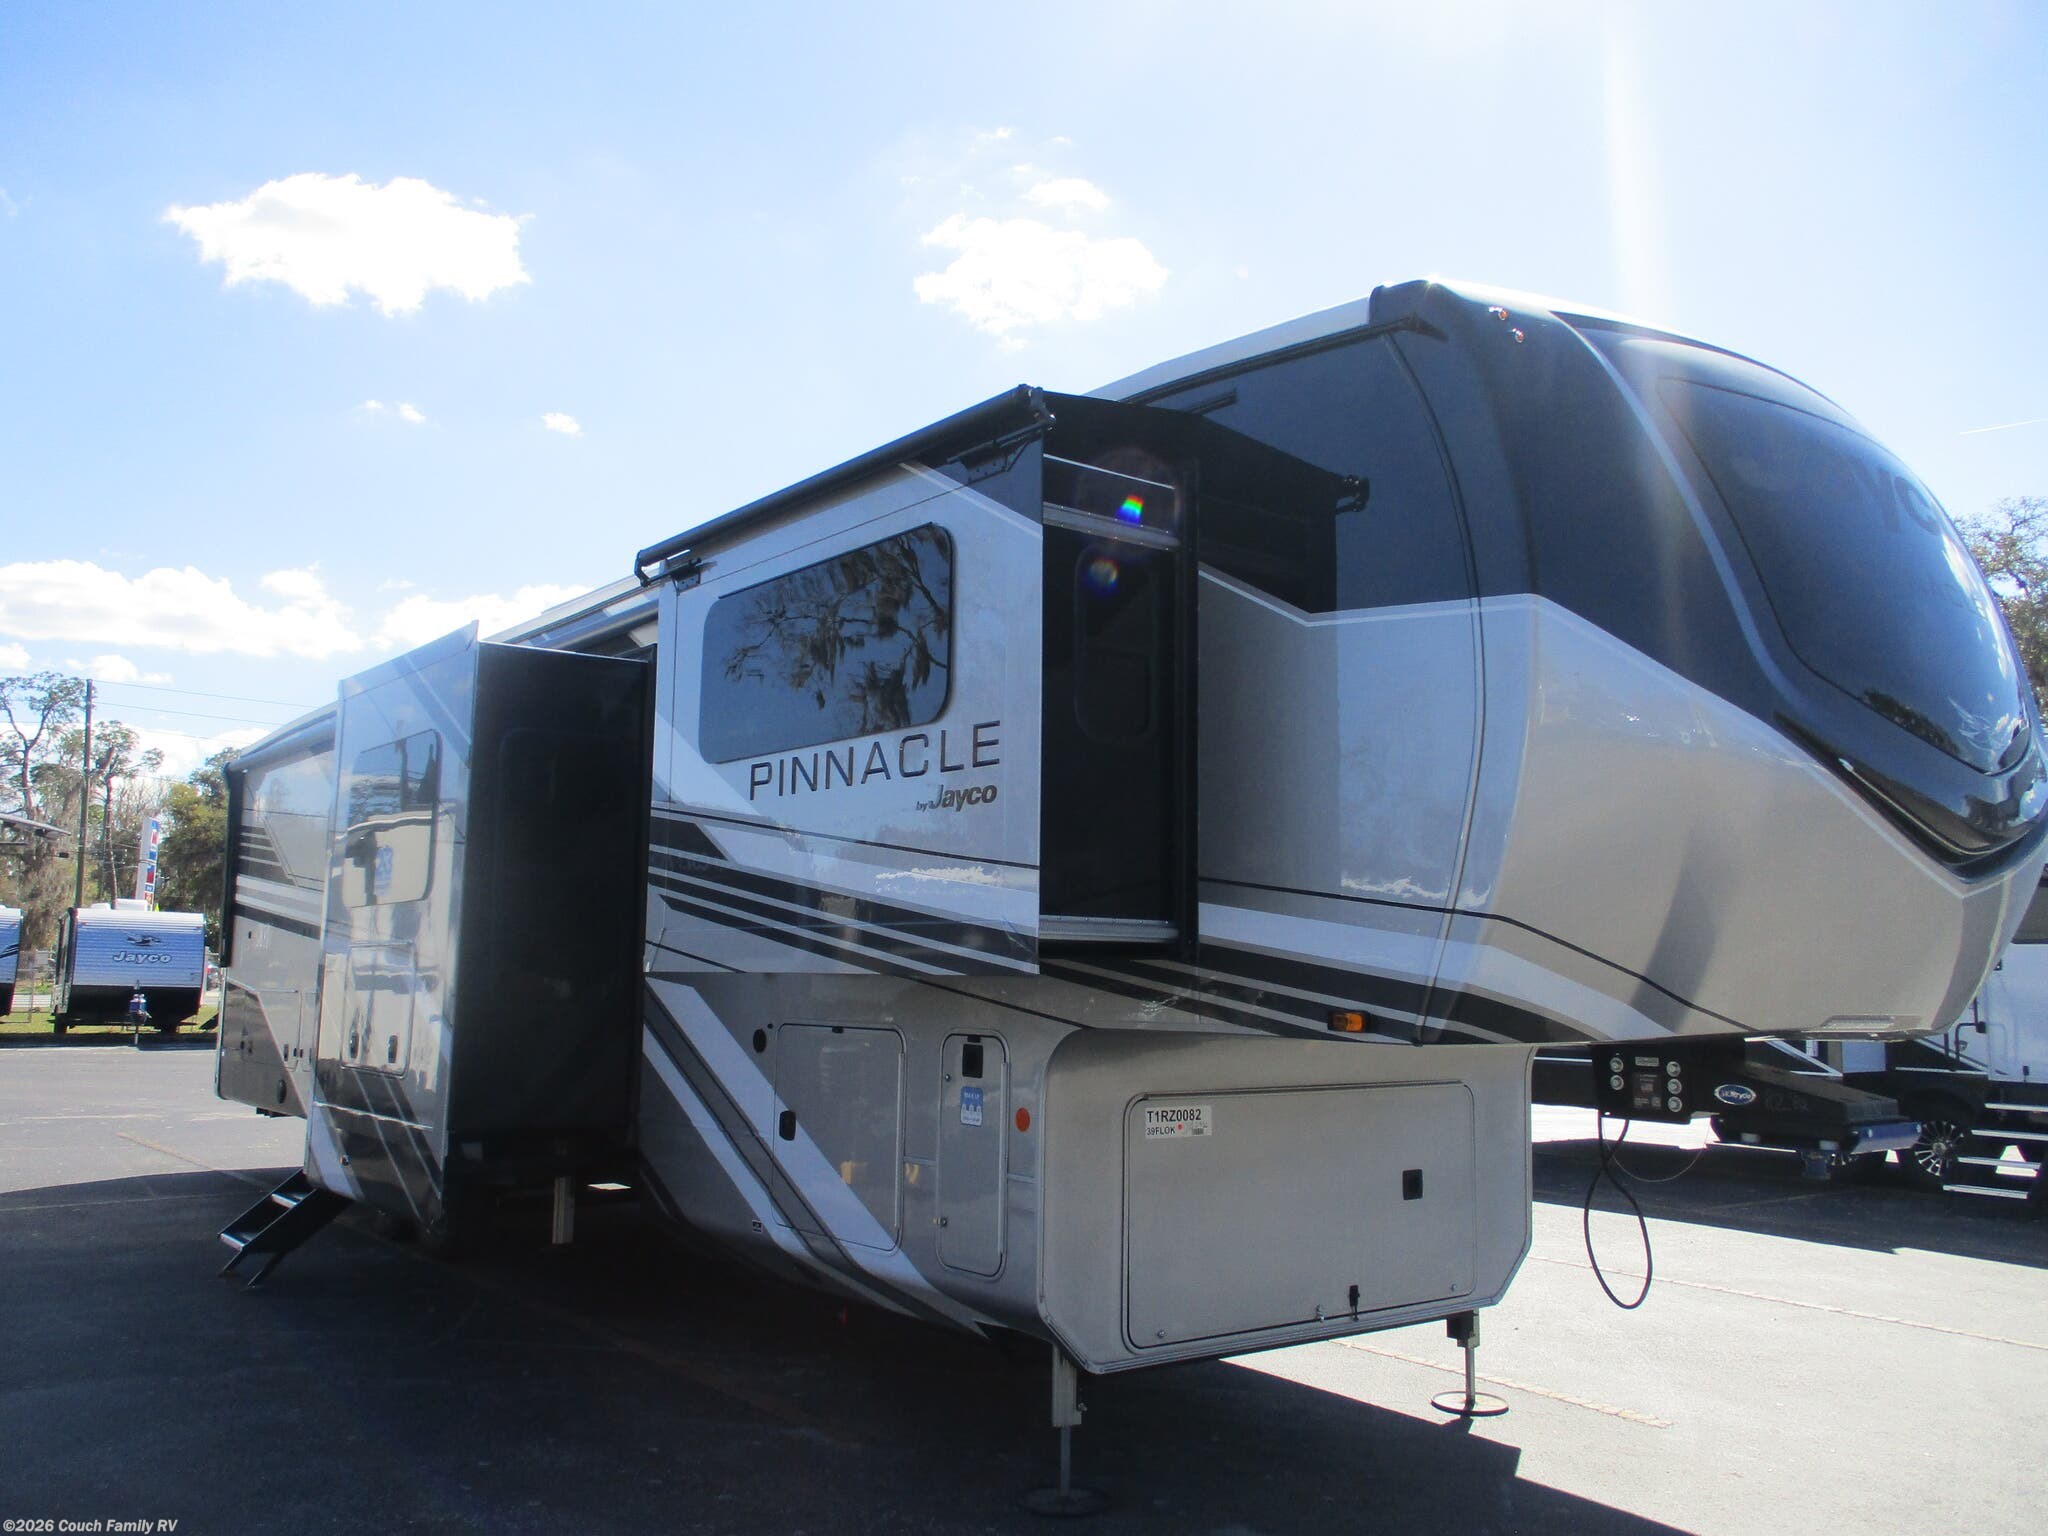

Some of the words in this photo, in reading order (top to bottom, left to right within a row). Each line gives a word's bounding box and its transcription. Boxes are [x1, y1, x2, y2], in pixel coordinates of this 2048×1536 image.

[750, 720, 1000, 801] PINNACLE
[914, 800, 928, 812] by
[928, 784, 997, 812] Jayco
[112, 950, 172, 964] Jayco
[1146, 1108, 1202, 1123] T1RZ0082
